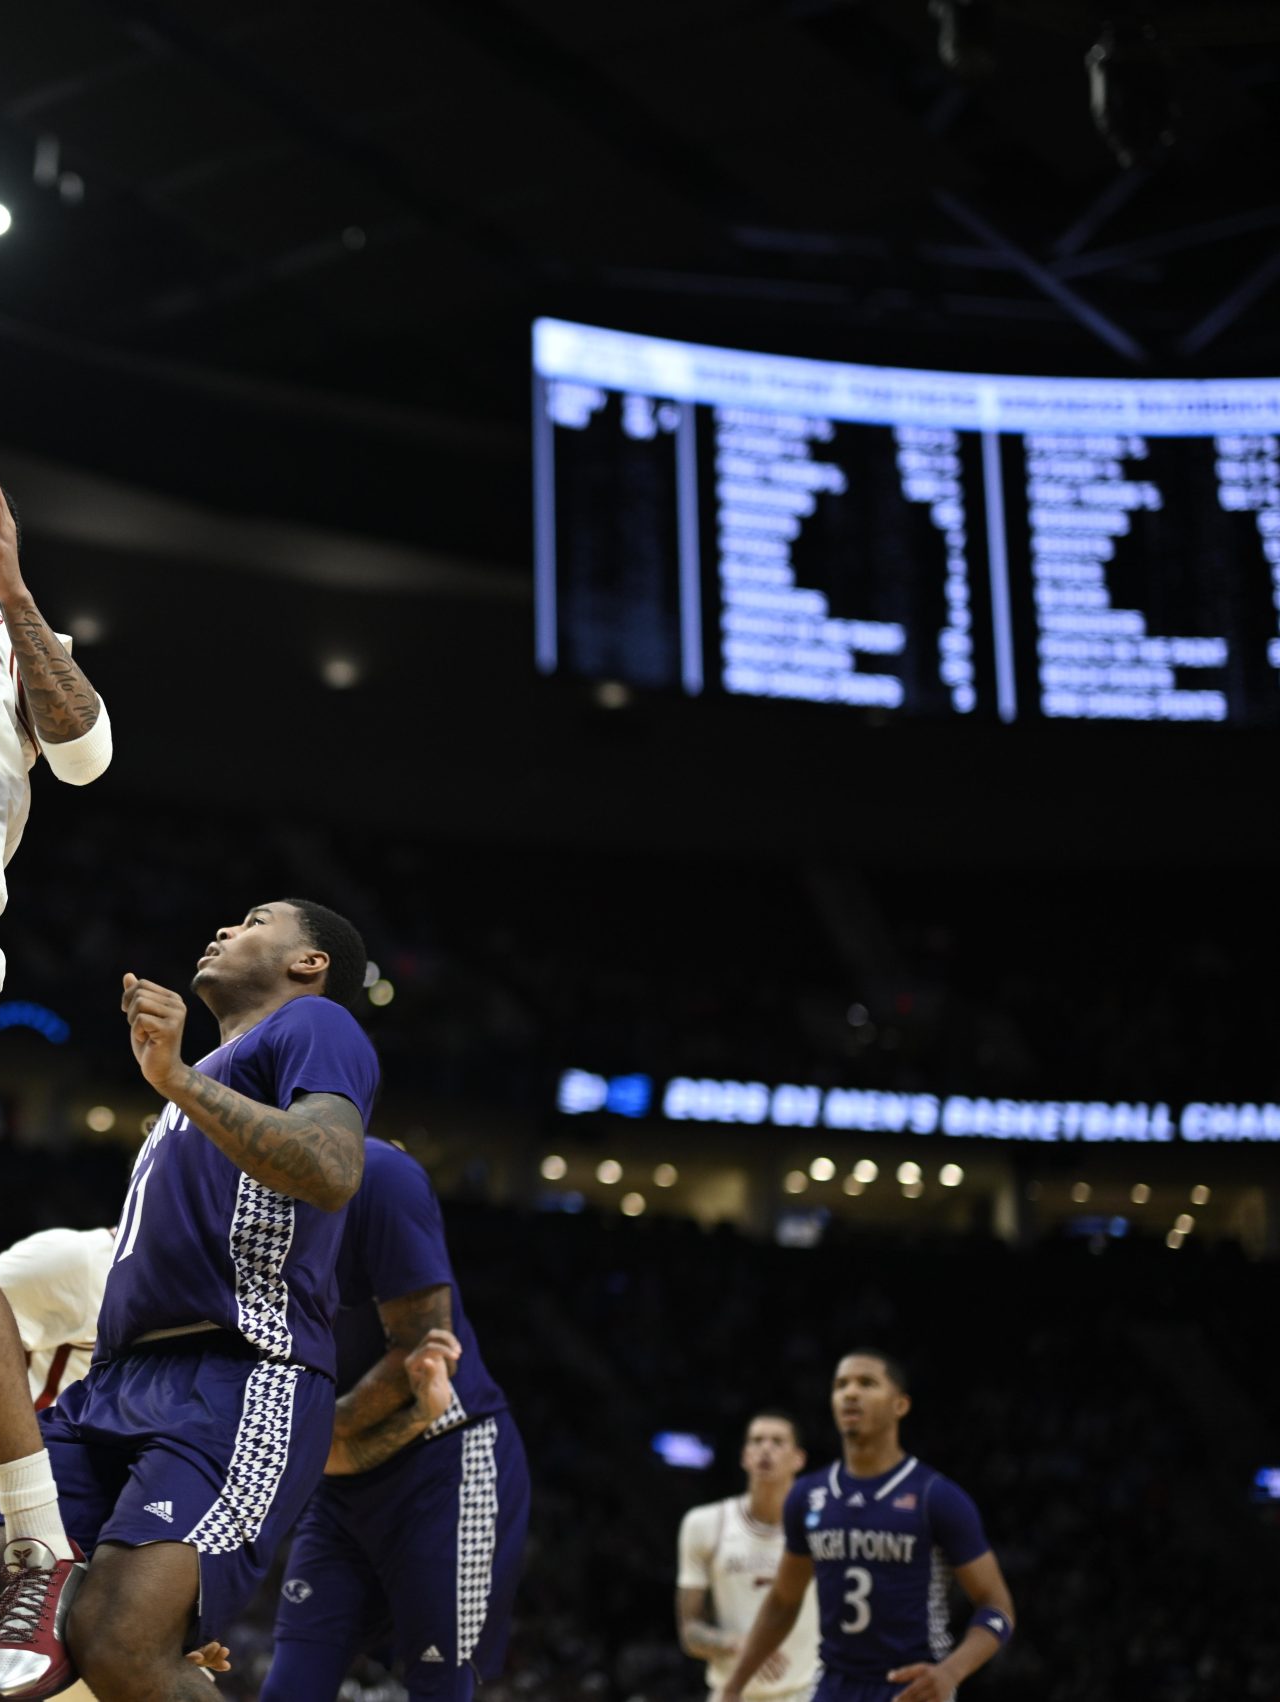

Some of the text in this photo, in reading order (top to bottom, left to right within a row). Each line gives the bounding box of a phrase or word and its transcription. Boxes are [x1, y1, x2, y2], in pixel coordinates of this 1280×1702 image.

[143, 1504, 174, 1523] adidas
[848, 1528, 917, 1564] POINT
[840, 1566, 873, 1634] 3
